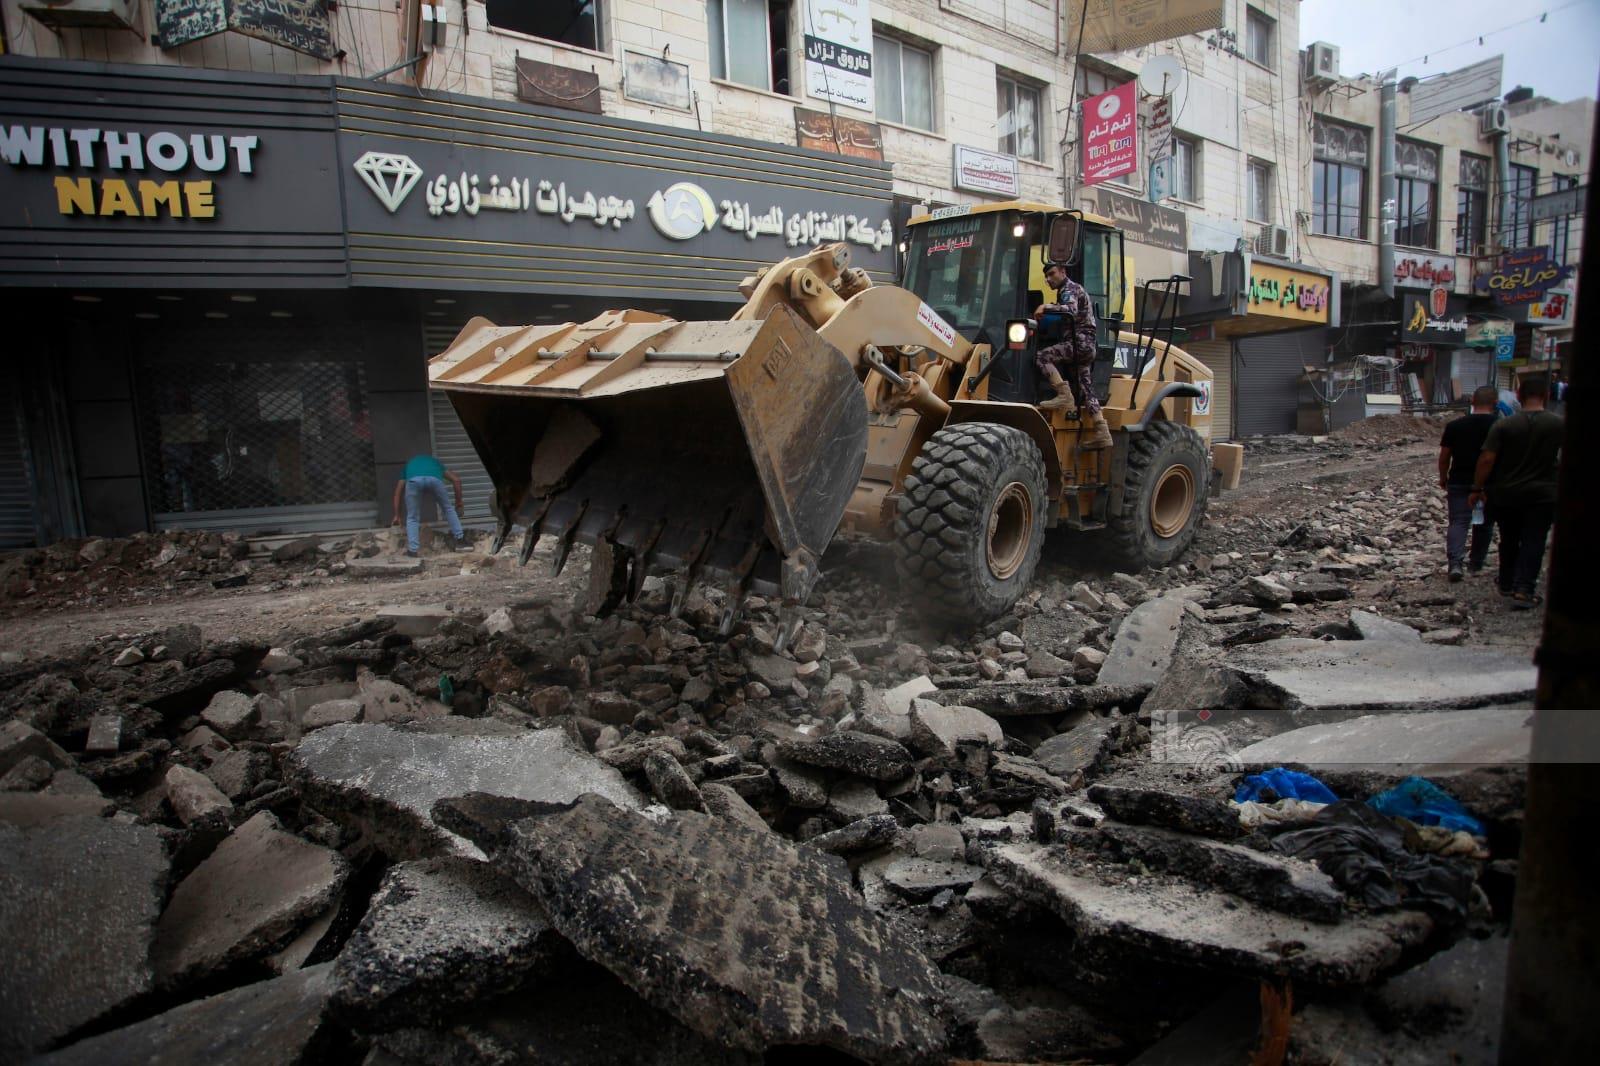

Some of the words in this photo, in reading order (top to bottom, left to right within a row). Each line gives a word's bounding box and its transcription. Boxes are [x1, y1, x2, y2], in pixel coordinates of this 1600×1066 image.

[808, 41, 835, 62] نزال
[838, 48, 869, 71] فاروق
[1087, 120, 1109, 144] تام
[1110, 112, 1132, 136] تيم
[0, 124, 258, 174] WITHOUT
[1108, 135, 1132, 154] Tam
[53, 176, 216, 218] NAME
[426, 171, 530, 216] العنزاوي
[535, 179, 635, 229] مجوهرات
[719, 199, 783, 240] للصرافة
[785, 210, 845, 248] العنزاوي
[845, 214, 893, 252] شركة
[1148, 208, 1180, 234] ستائر
